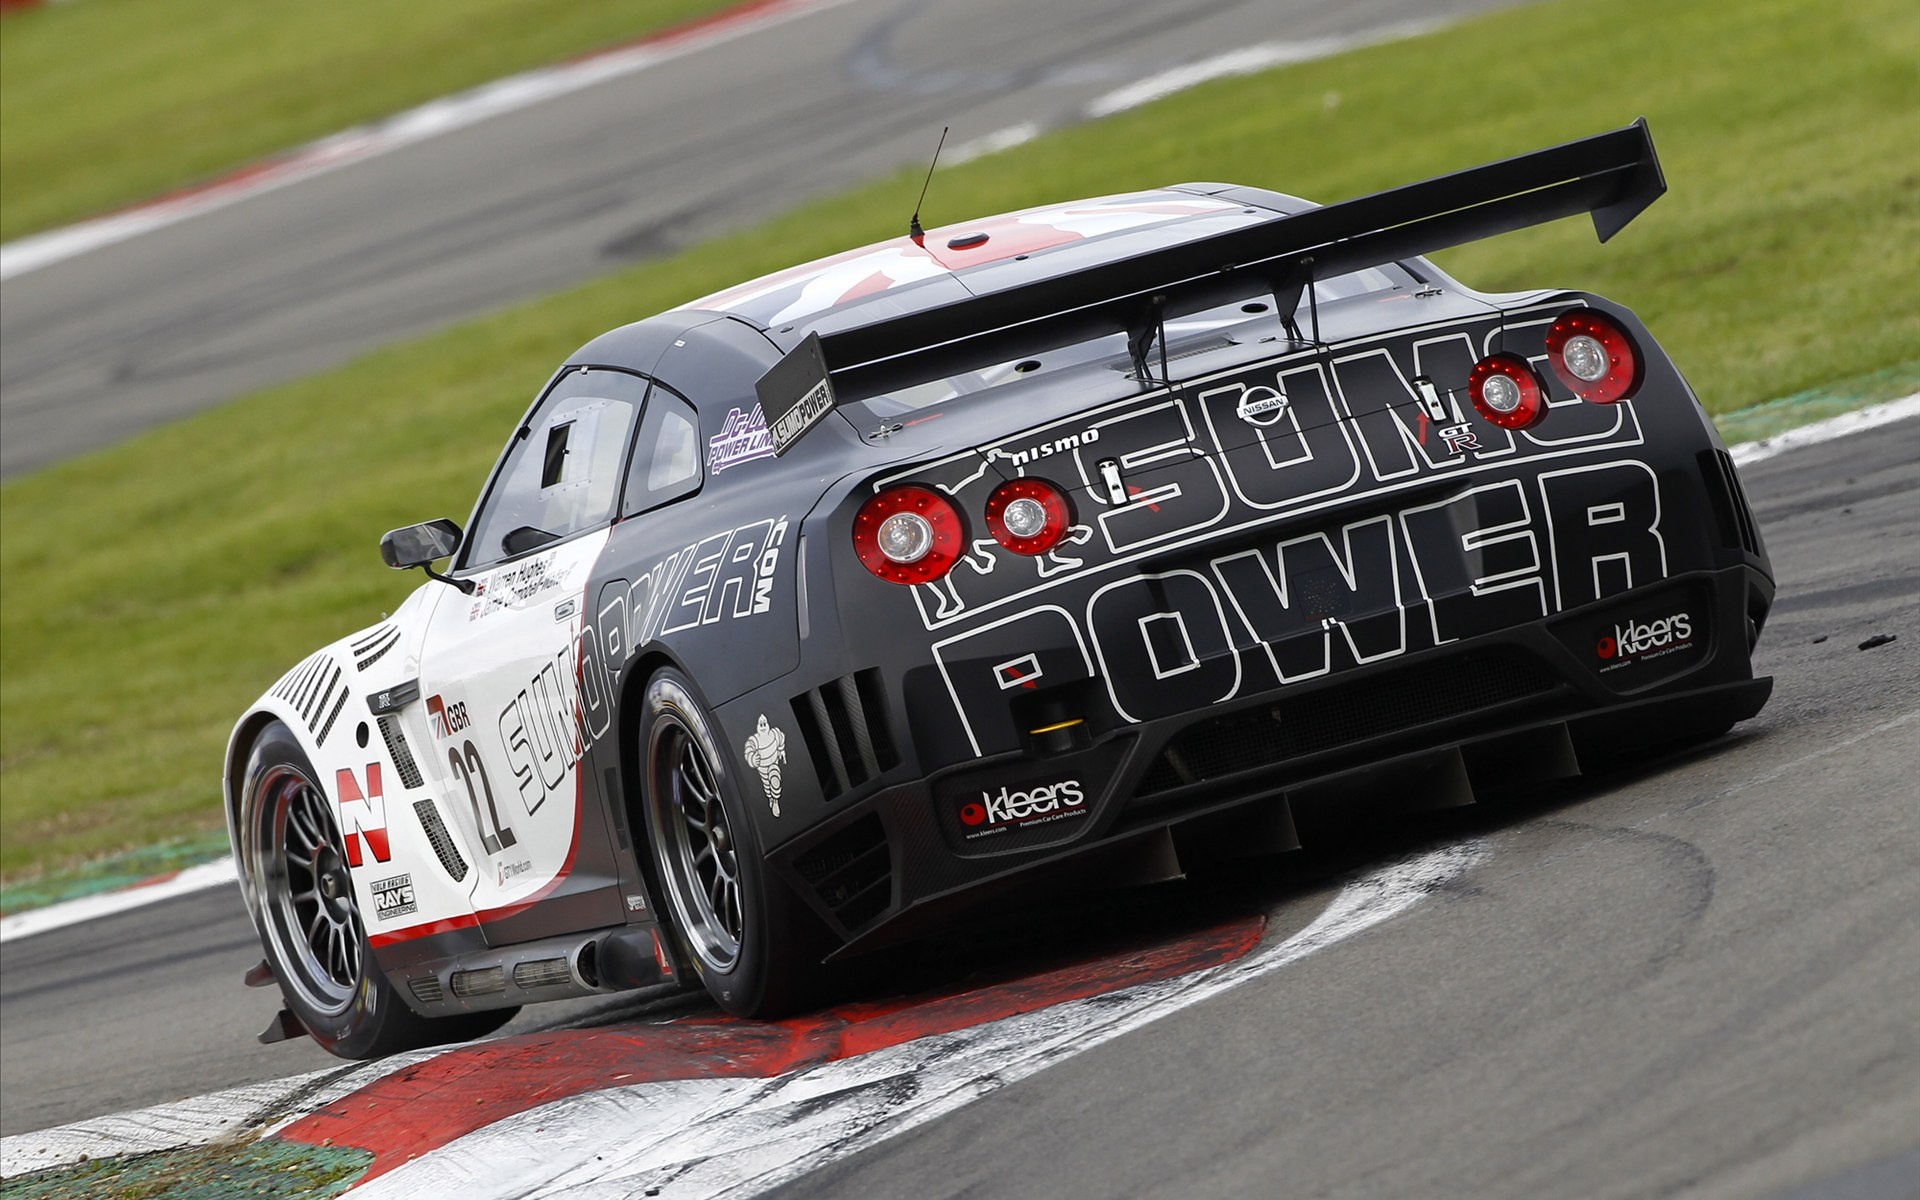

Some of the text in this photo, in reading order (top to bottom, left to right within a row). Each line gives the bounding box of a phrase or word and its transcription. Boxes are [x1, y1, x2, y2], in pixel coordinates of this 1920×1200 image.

[776, 384, 830, 445] SUMOPOWER
[1242, 398, 1285, 416] NISSAN
[708, 433, 774, 466] POWER LIN
[1011, 428, 1100, 467] nismo
[932, 458, 1668, 757] POWER
[1615, 613, 1692, 657] kleers
[447, 701, 471, 733] GBR
[448, 740, 517, 855] 22
[982, 780, 1085, 824] kleers
[966, 826, 1008, 840] www.kleers.com
[1019, 808, 1087, 828] Premium Car Care Products
[373, 886, 415, 911] RAYS
[378, 903, 416, 919] ENGINEERING
